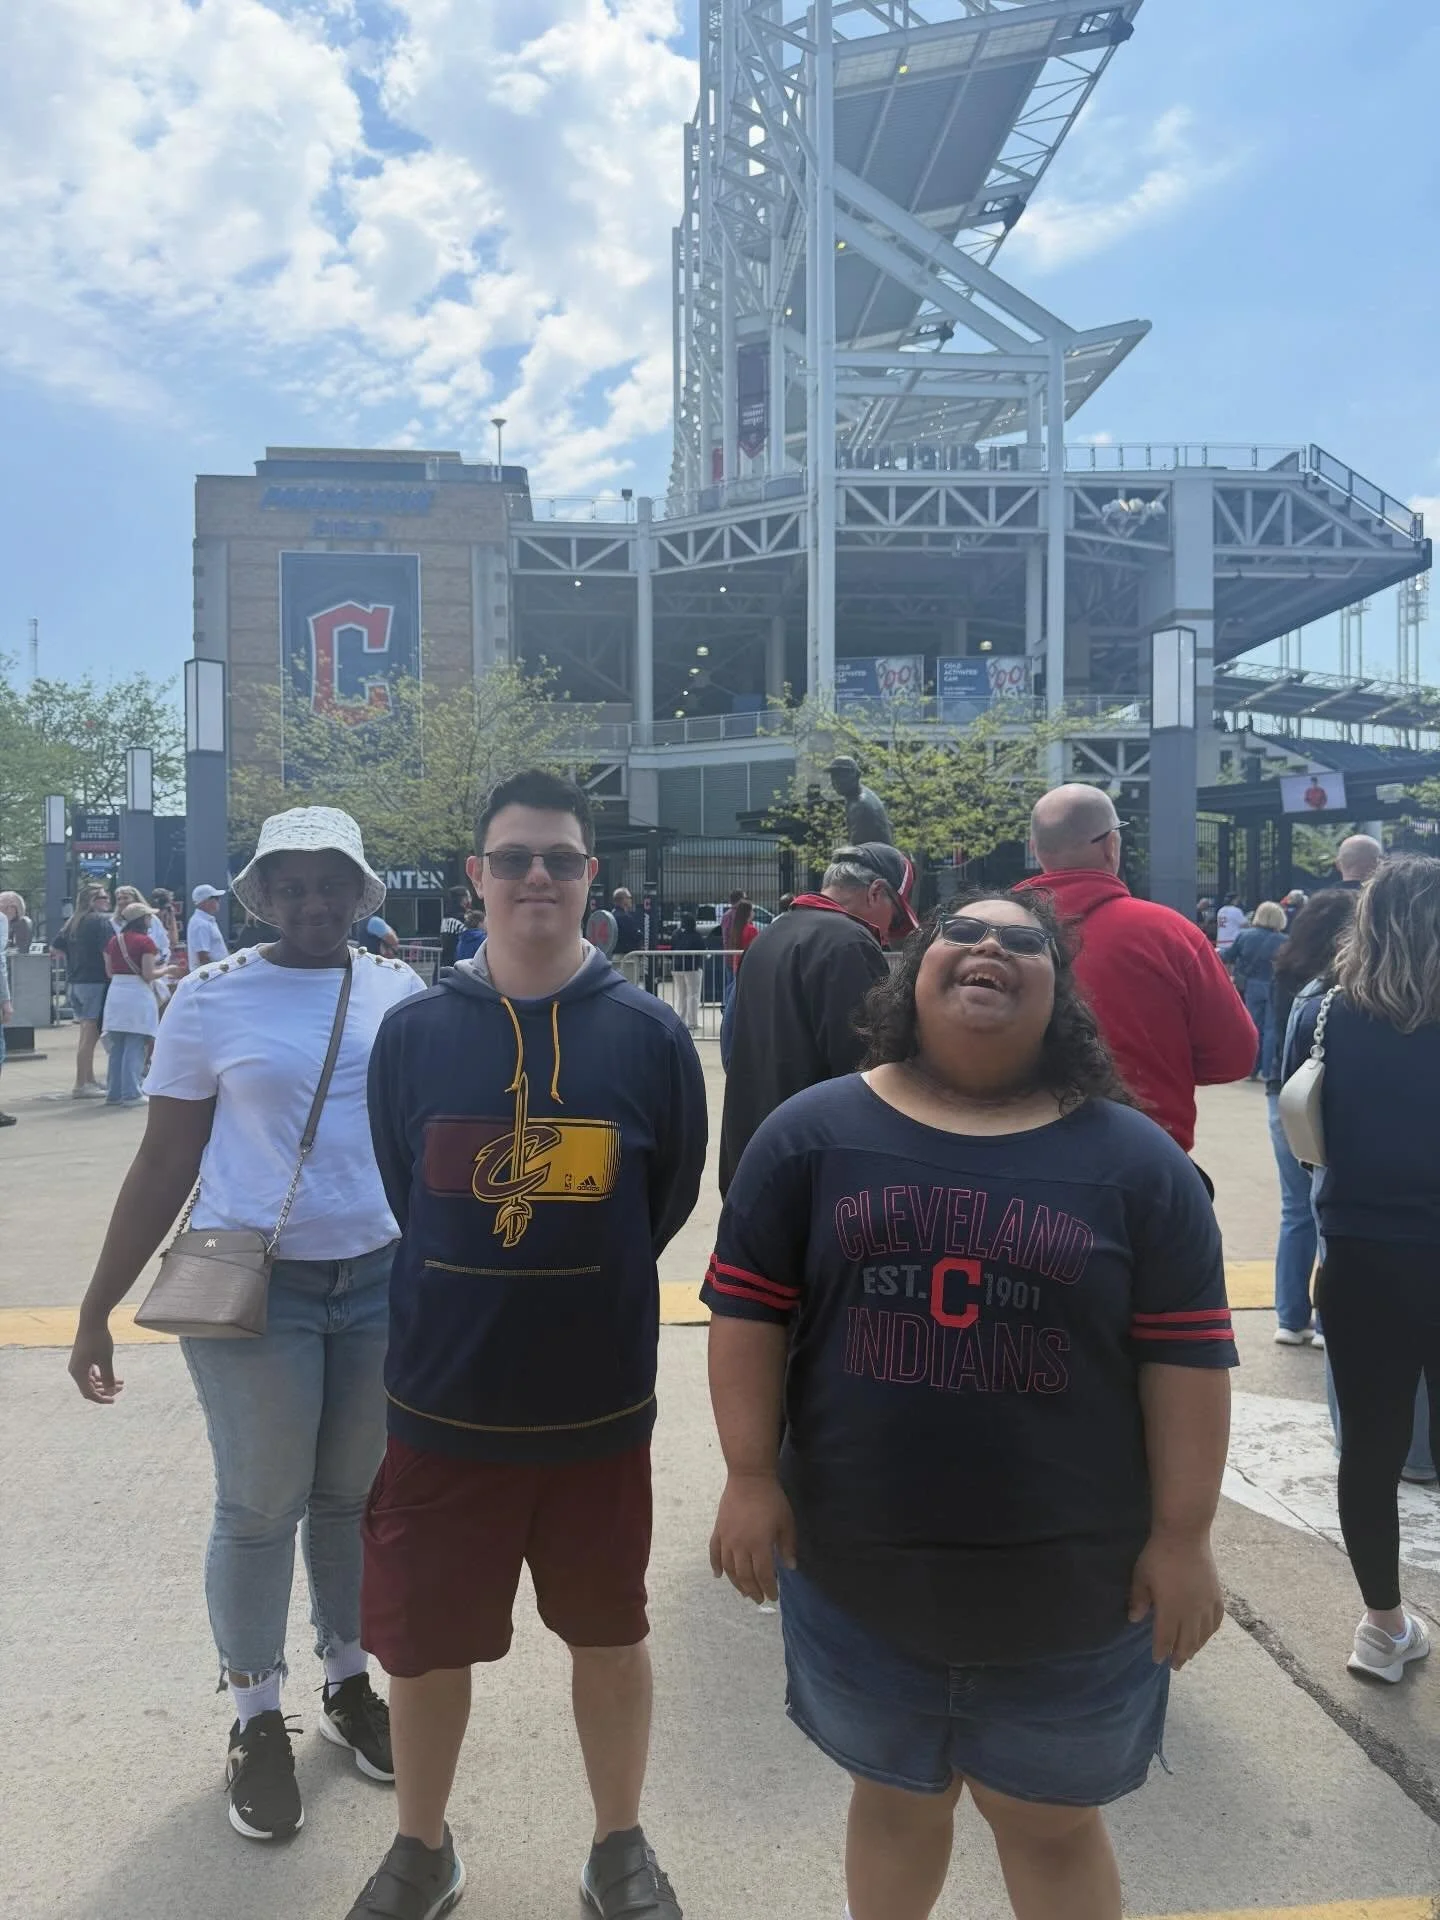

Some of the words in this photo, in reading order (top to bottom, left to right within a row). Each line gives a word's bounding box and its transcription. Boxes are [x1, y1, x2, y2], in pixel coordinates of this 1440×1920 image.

[307, 600, 394, 728] C
[834, 1185, 1095, 1285] CLEVELAND
[862, 1264, 928, 1299] EST.
[930, 1257, 982, 1329] C
[984, 1271, 1041, 1312] 1901
[843, 1306, 1071, 1394] INDIANS
